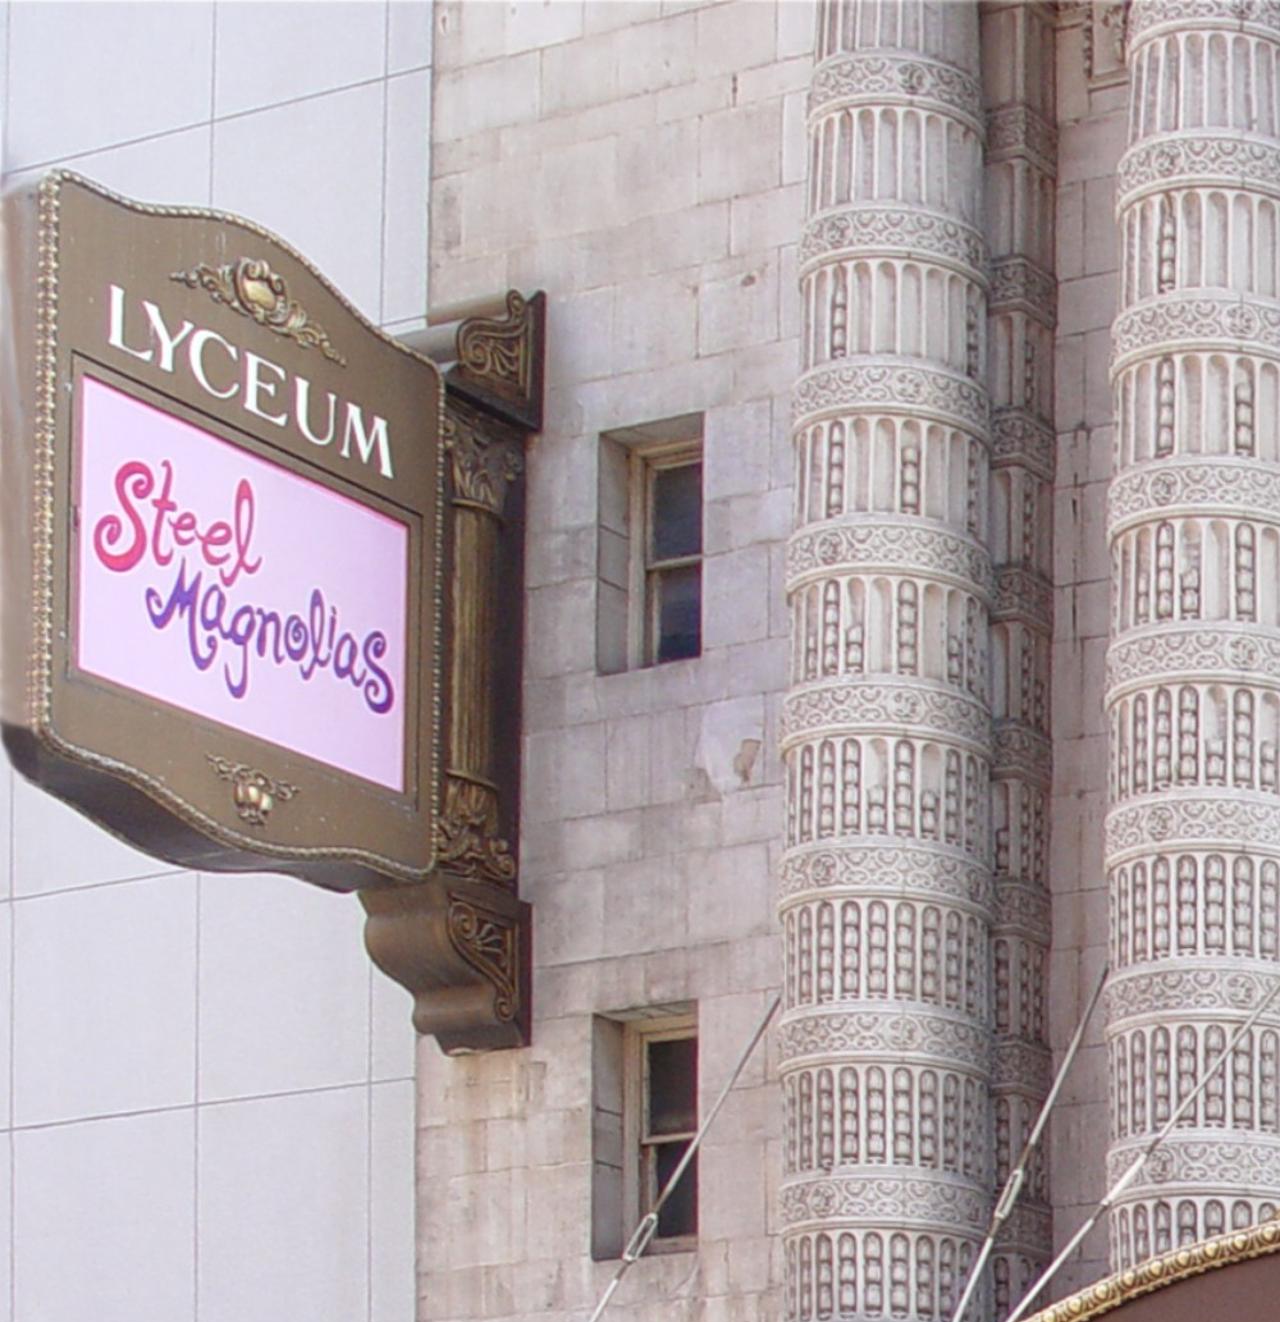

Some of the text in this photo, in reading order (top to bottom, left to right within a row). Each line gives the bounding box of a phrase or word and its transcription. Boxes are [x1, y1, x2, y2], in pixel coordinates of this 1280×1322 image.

[108, 283, 395, 478] LYCEUM
[94, 459, 262, 585] Steel
[145, 557, 394, 715] Magnolias
